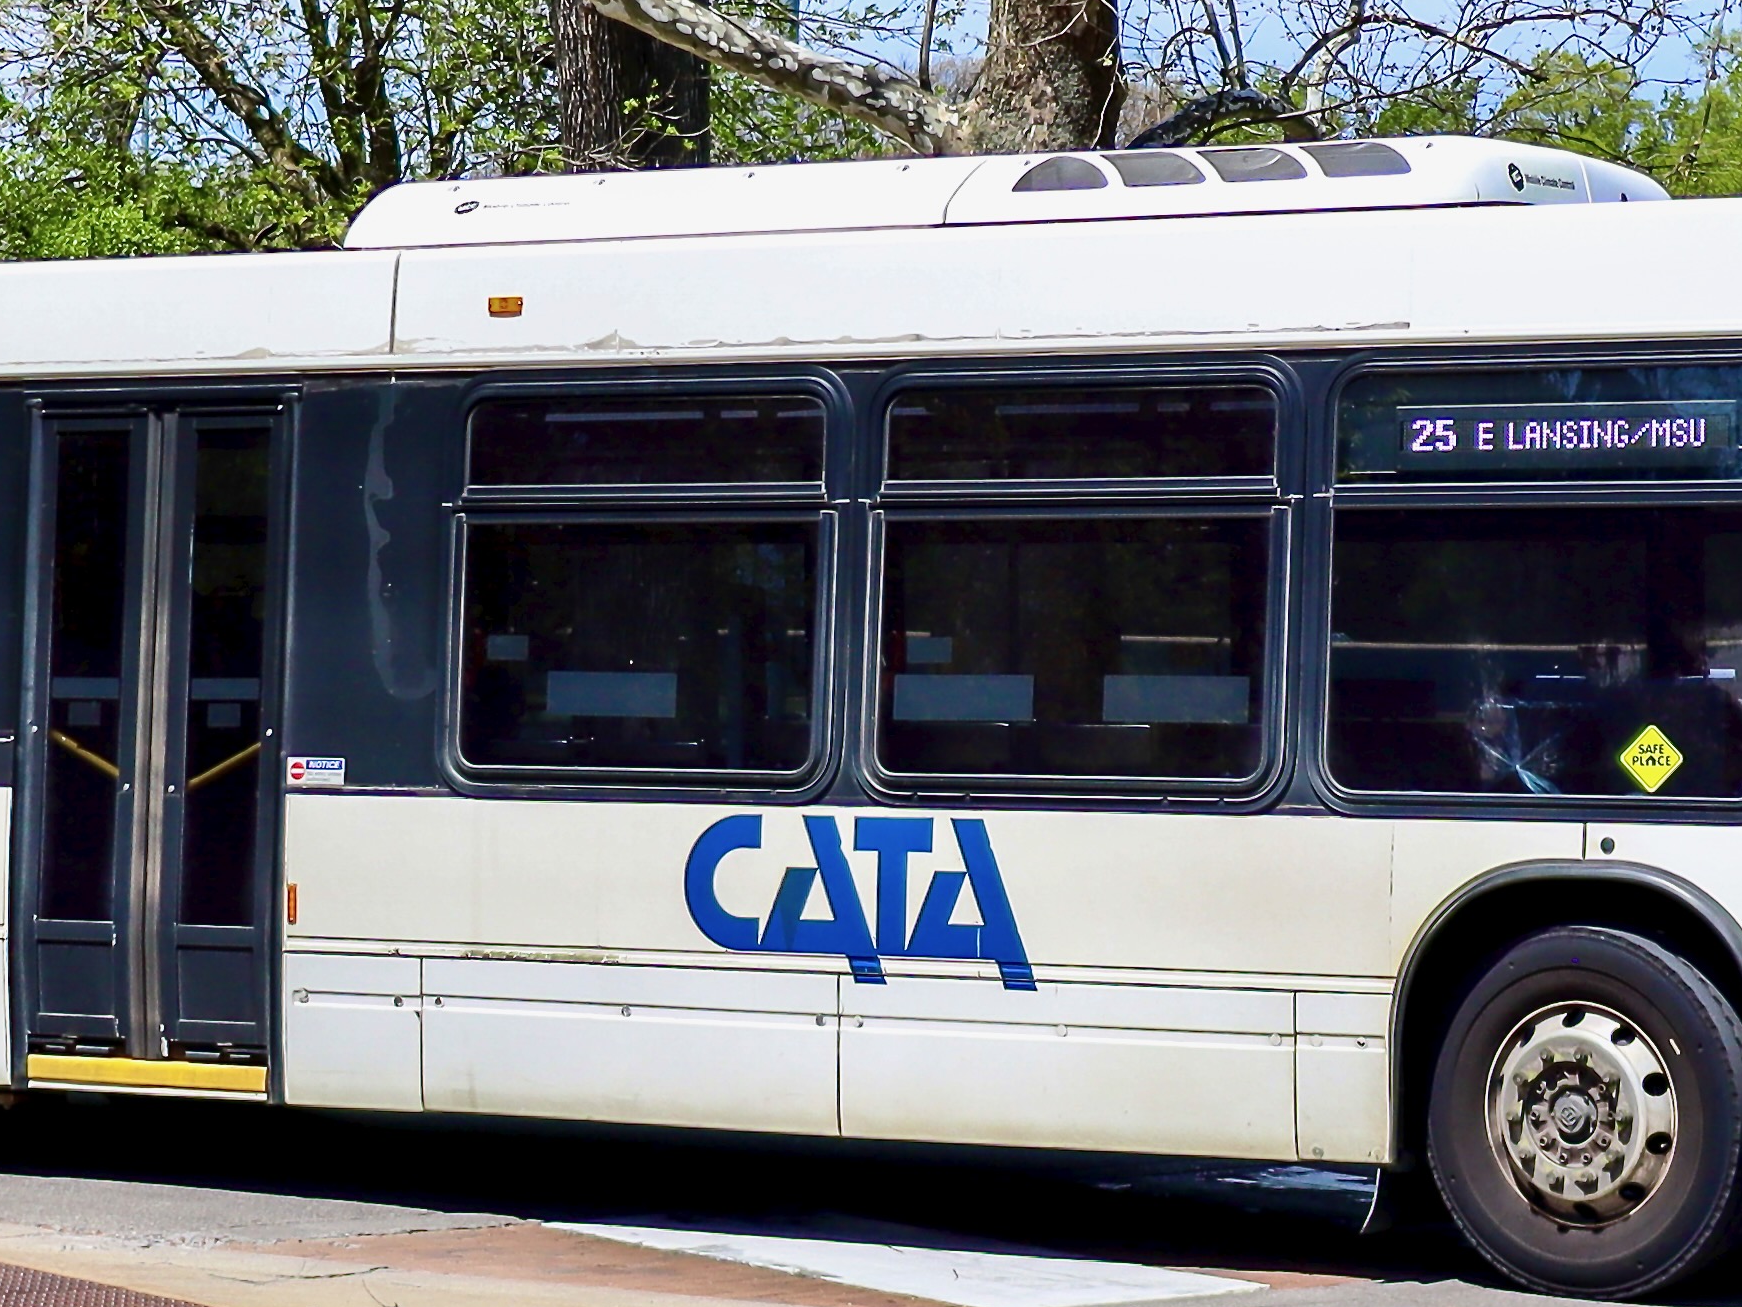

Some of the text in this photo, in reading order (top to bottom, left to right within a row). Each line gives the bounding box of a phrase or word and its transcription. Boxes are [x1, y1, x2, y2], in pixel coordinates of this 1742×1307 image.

[1411, 418, 1706, 451] 25 E LANSING/MSU
[1638, 743, 1664, 754] SAFE
[308, 760, 341, 769] NOTICE
[684, 814, 1038, 991] CATA
